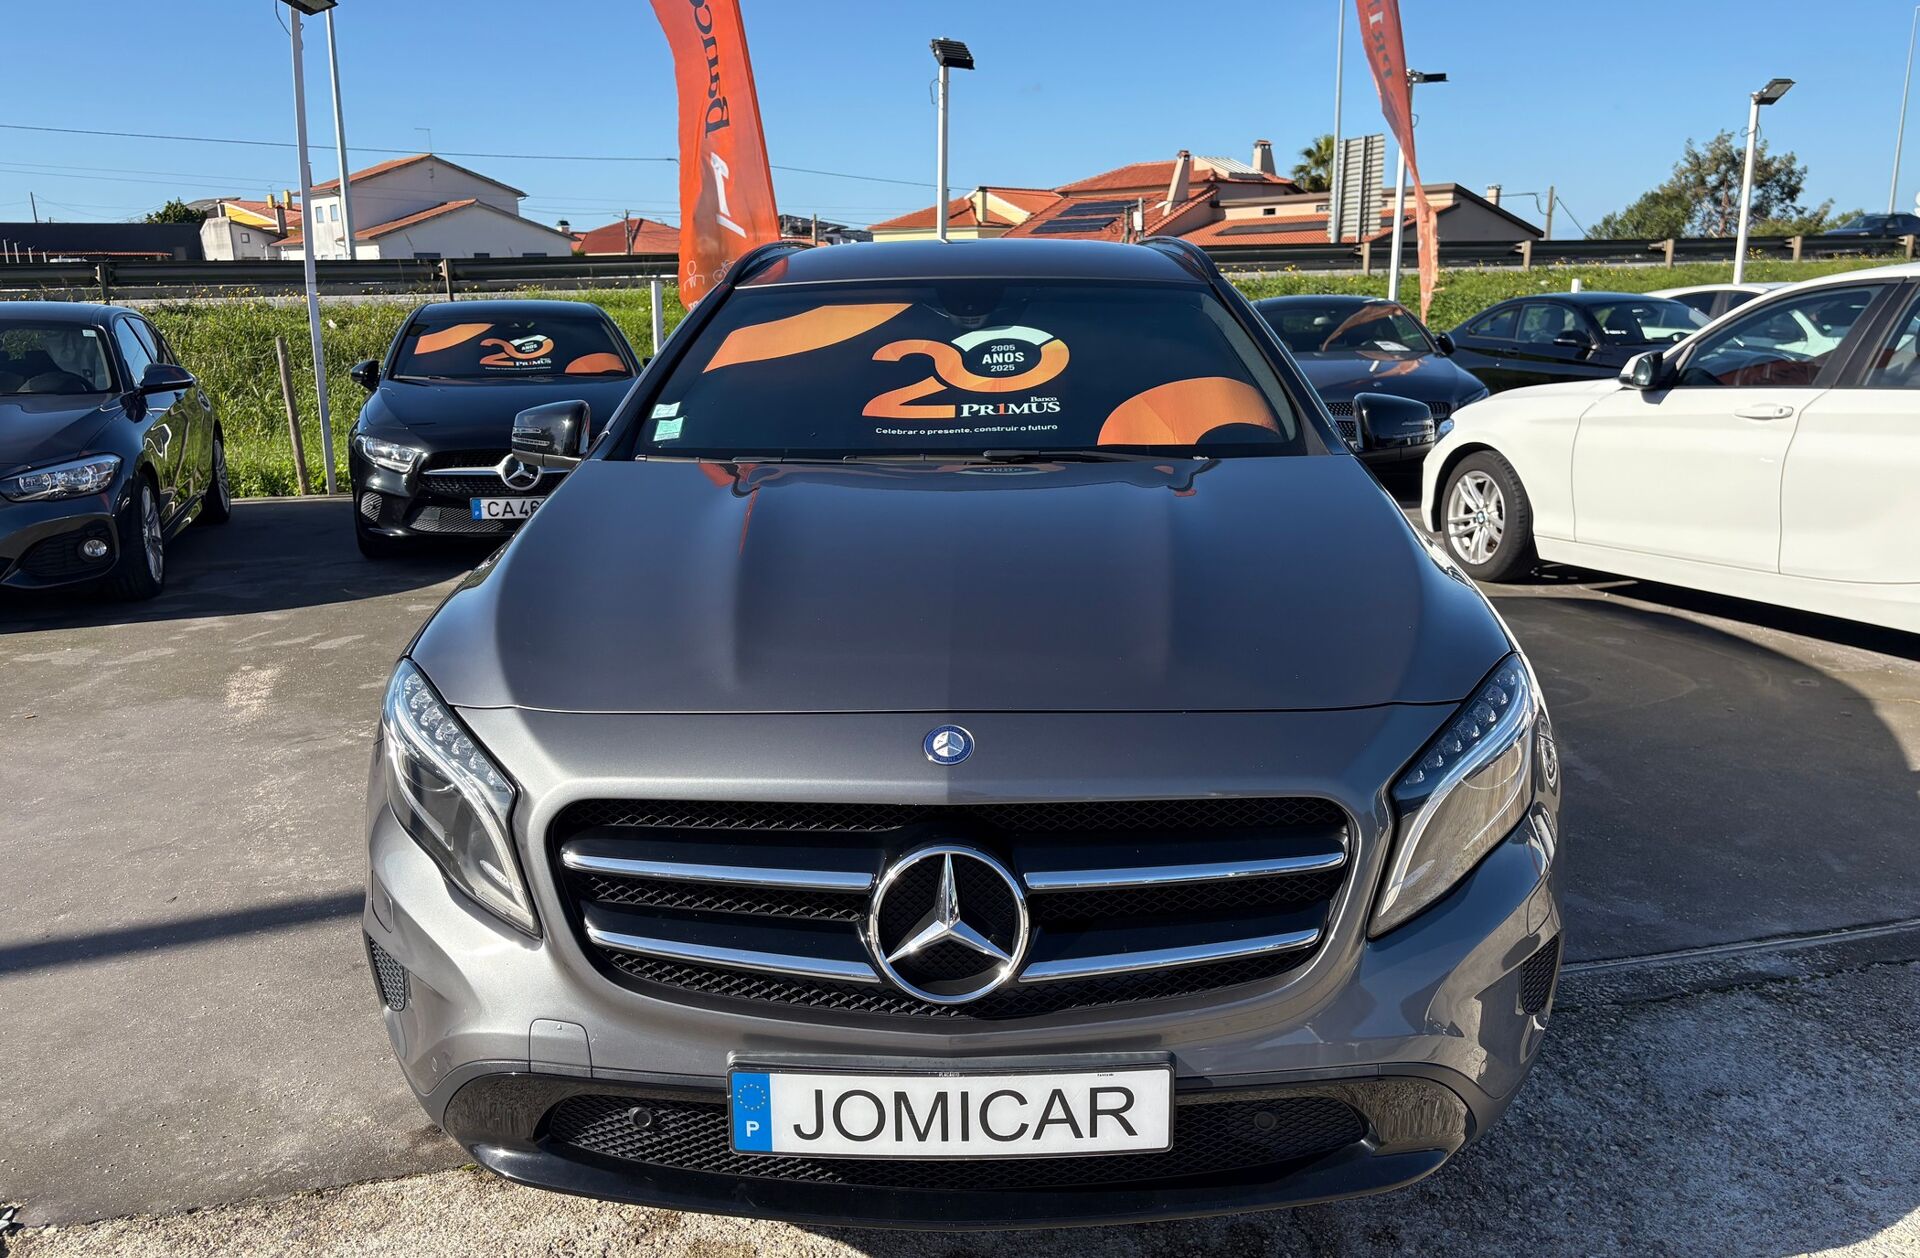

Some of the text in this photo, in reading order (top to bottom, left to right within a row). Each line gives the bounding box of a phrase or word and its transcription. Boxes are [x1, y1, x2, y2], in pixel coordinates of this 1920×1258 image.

[991, 344, 1016, 352] 2005
[982, 352, 1025, 364] ANOS
[990, 364, 1016, 372] 2025
[875, 427, 918, 435] Celebrar
[487, 501, 516, 517] CA
[793, 1086, 1138, 1142] JOMICAR
[746, 1120, 760, 1138] P
